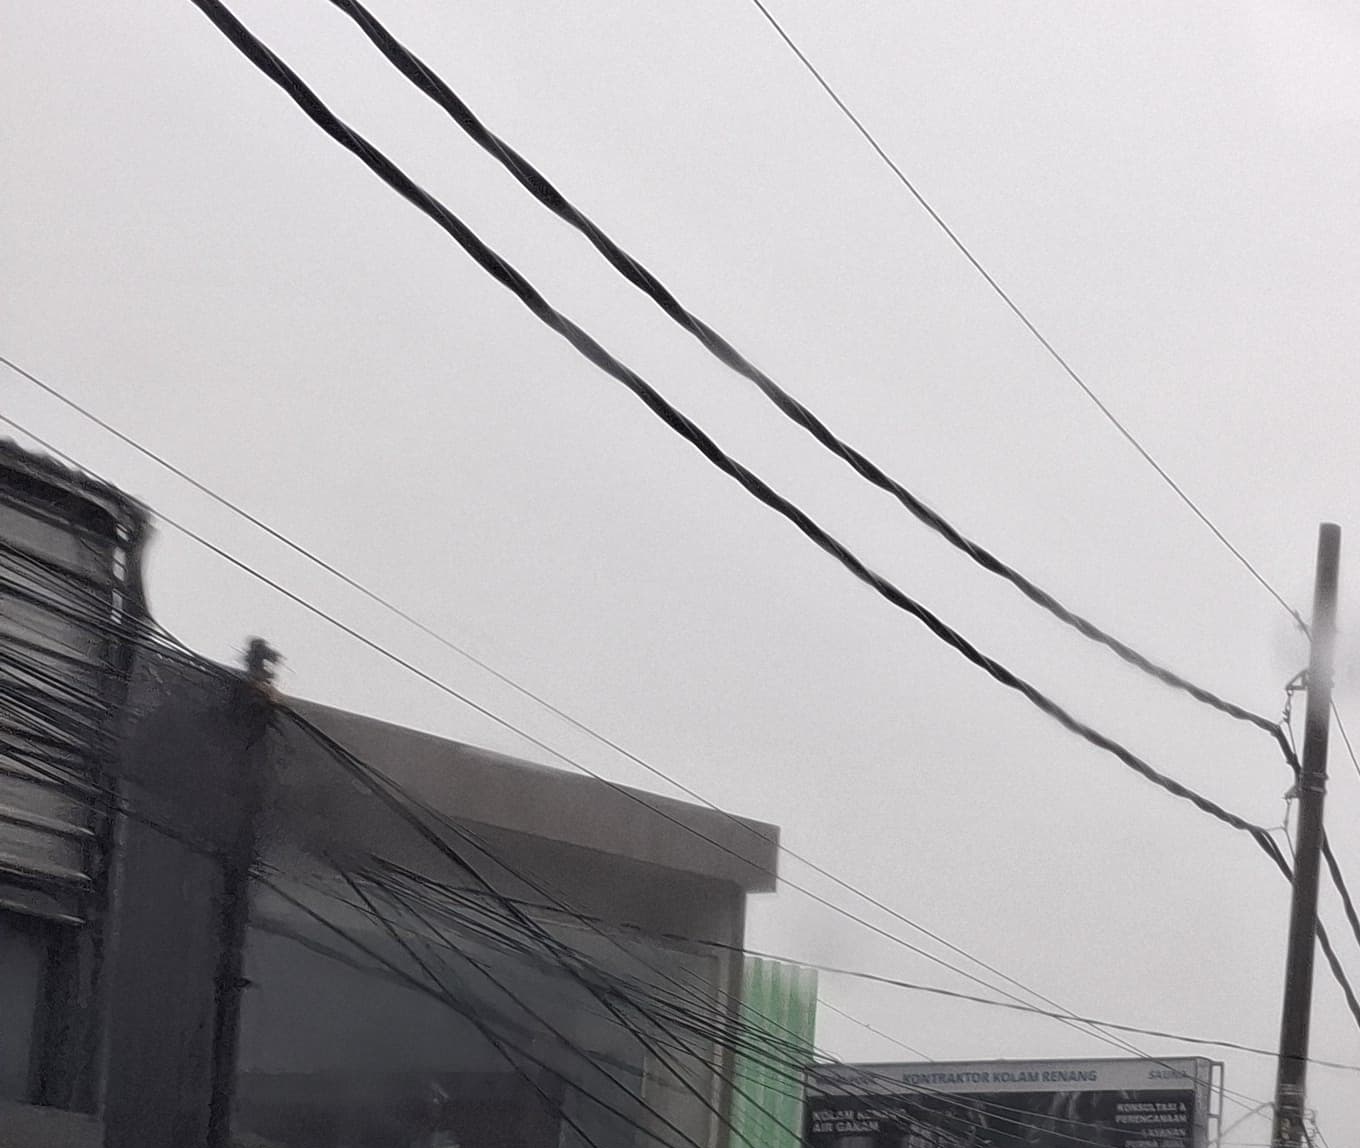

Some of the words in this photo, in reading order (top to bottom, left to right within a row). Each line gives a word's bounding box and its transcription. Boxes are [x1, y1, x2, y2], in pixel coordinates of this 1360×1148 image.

[902, 1072, 990, 1085] KONTRAKTOR
[992, 1072, 1039, 1084] KOLAM
[1042, 1070, 1098, 1083] RENANG
